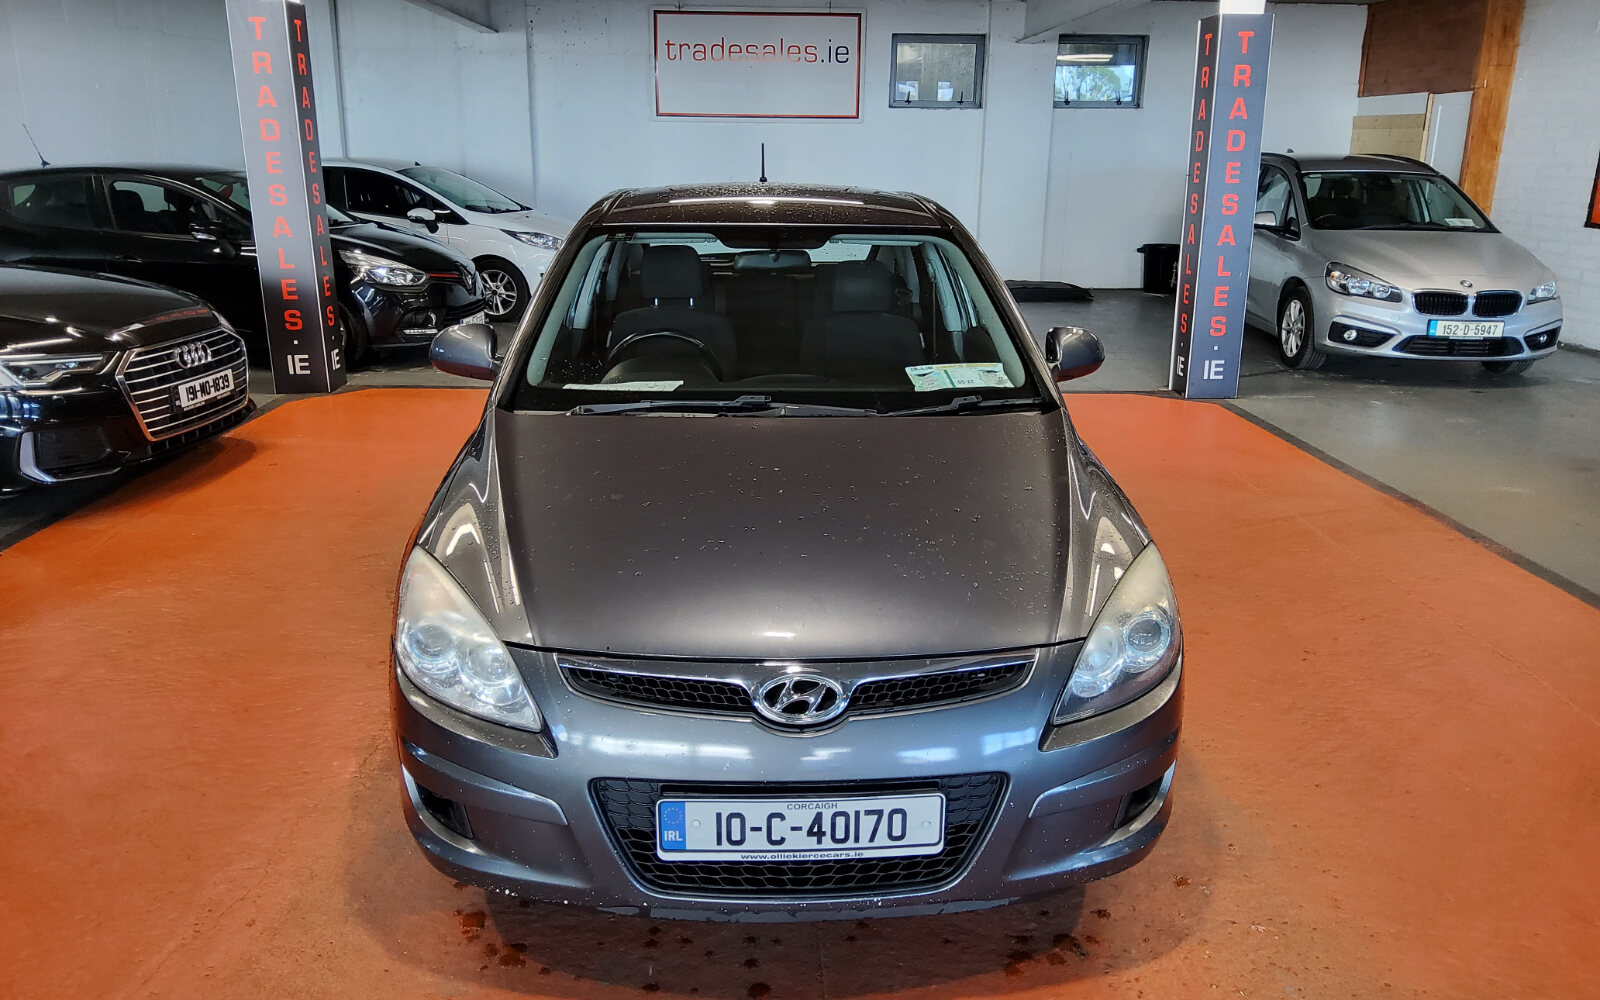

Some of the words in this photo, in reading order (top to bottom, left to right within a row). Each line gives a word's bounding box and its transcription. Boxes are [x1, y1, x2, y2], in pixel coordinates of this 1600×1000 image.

[665, 36, 850, 63] tradesales.ie
[1442, 324, 1498, 336] 152-D-5947
[185, 373, 230, 402] 191-MO-1839
[786, 802, 838, 811] CORCAIGH
[715, 808, 908, 847] 10-C-40170
[663, 830, 684, 842] IRL
[740, 851, 864, 860] www.olliekiercecars.ie
